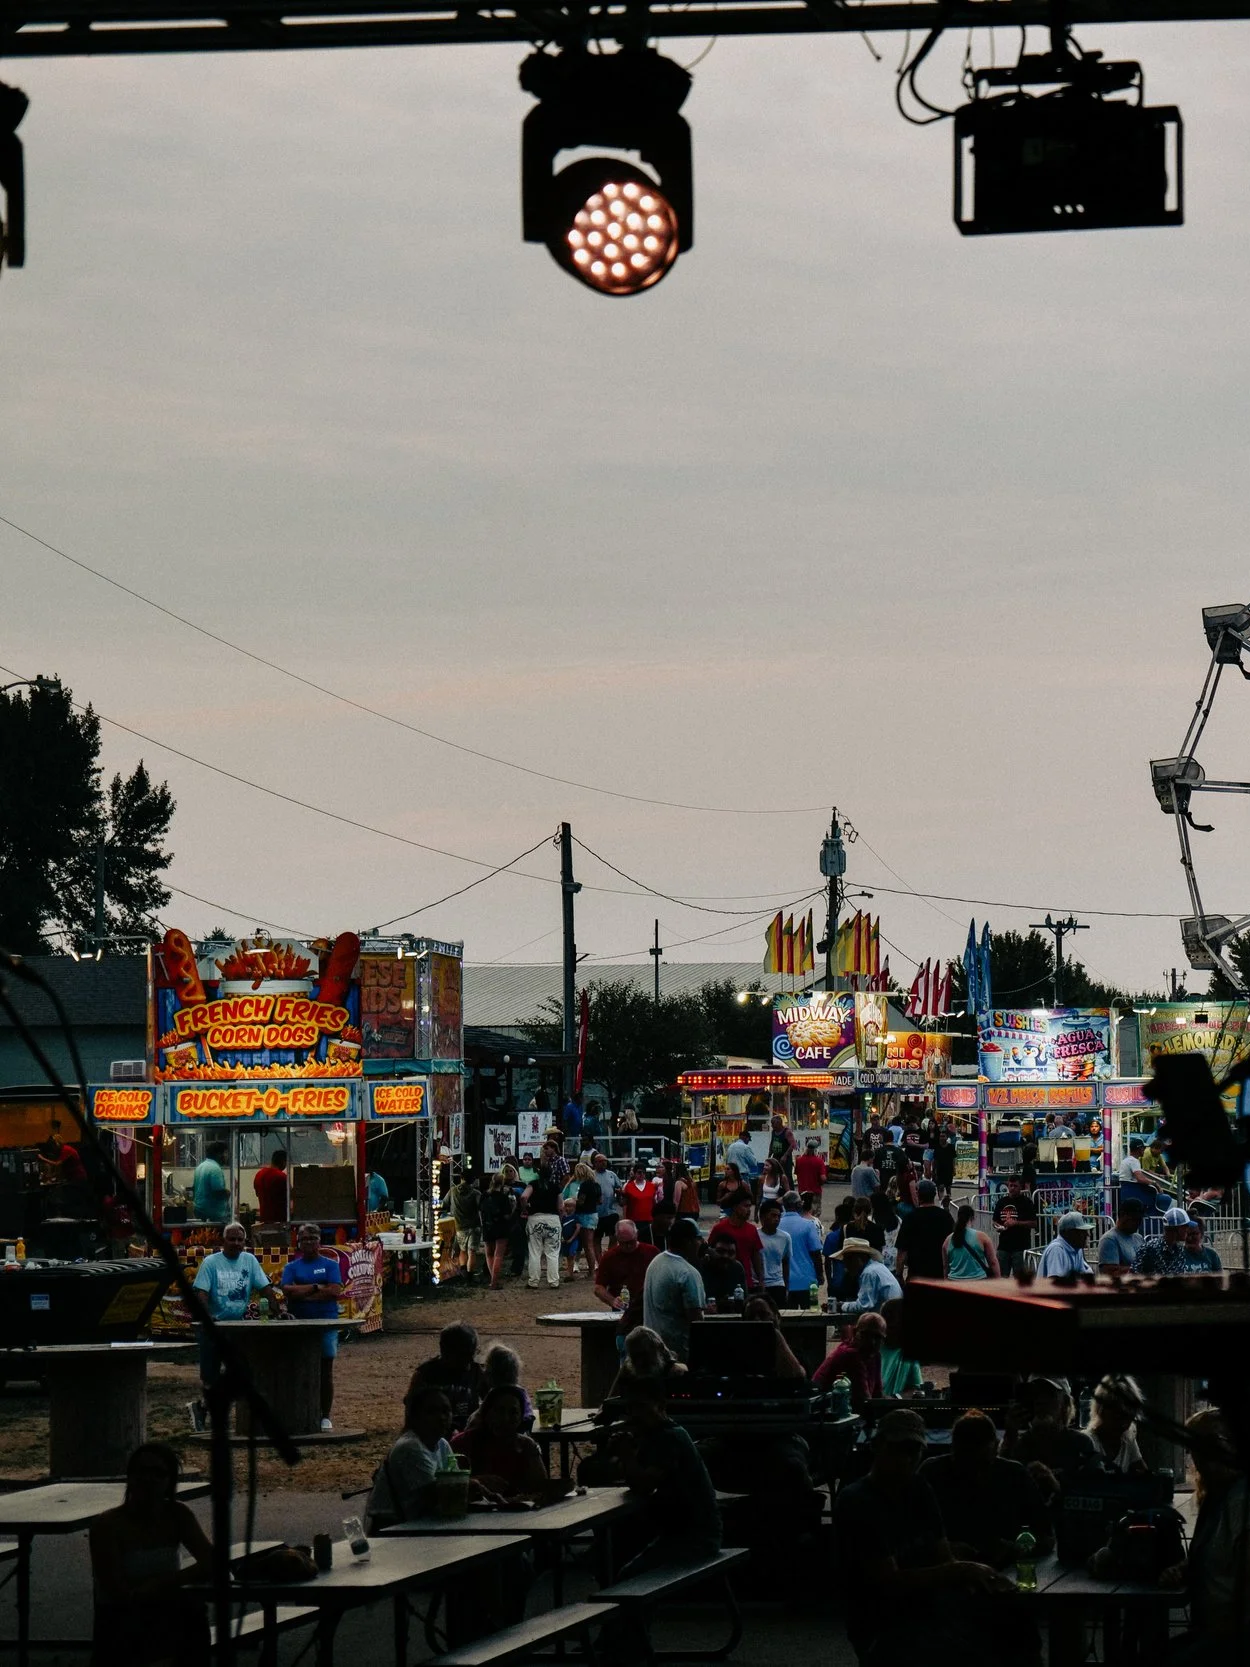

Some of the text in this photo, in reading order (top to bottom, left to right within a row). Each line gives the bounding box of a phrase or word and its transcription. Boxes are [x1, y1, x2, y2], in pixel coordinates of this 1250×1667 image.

[175, 997, 348, 1036] FRENCH FRIES
[776, 1006, 851, 1025] MIDWAY
[993, 1010, 1046, 1032] SLUSHIES
[208, 1025, 317, 1045] CORN DOGS
[1058, 1029, 1095, 1046] AGUA
[795, 1046, 831, 1059] CAFE
[1053, 1040, 1105, 1059] FRESCA
[95, 1091, 151, 1102] ICE COLD
[178, 1088, 347, 1112] BUCKET-O-FRIES
[375, 1086, 423, 1098] ICE COLD
[94, 1103, 148, 1117] DRINKS
[376, 1099, 421, 1111] WATER
